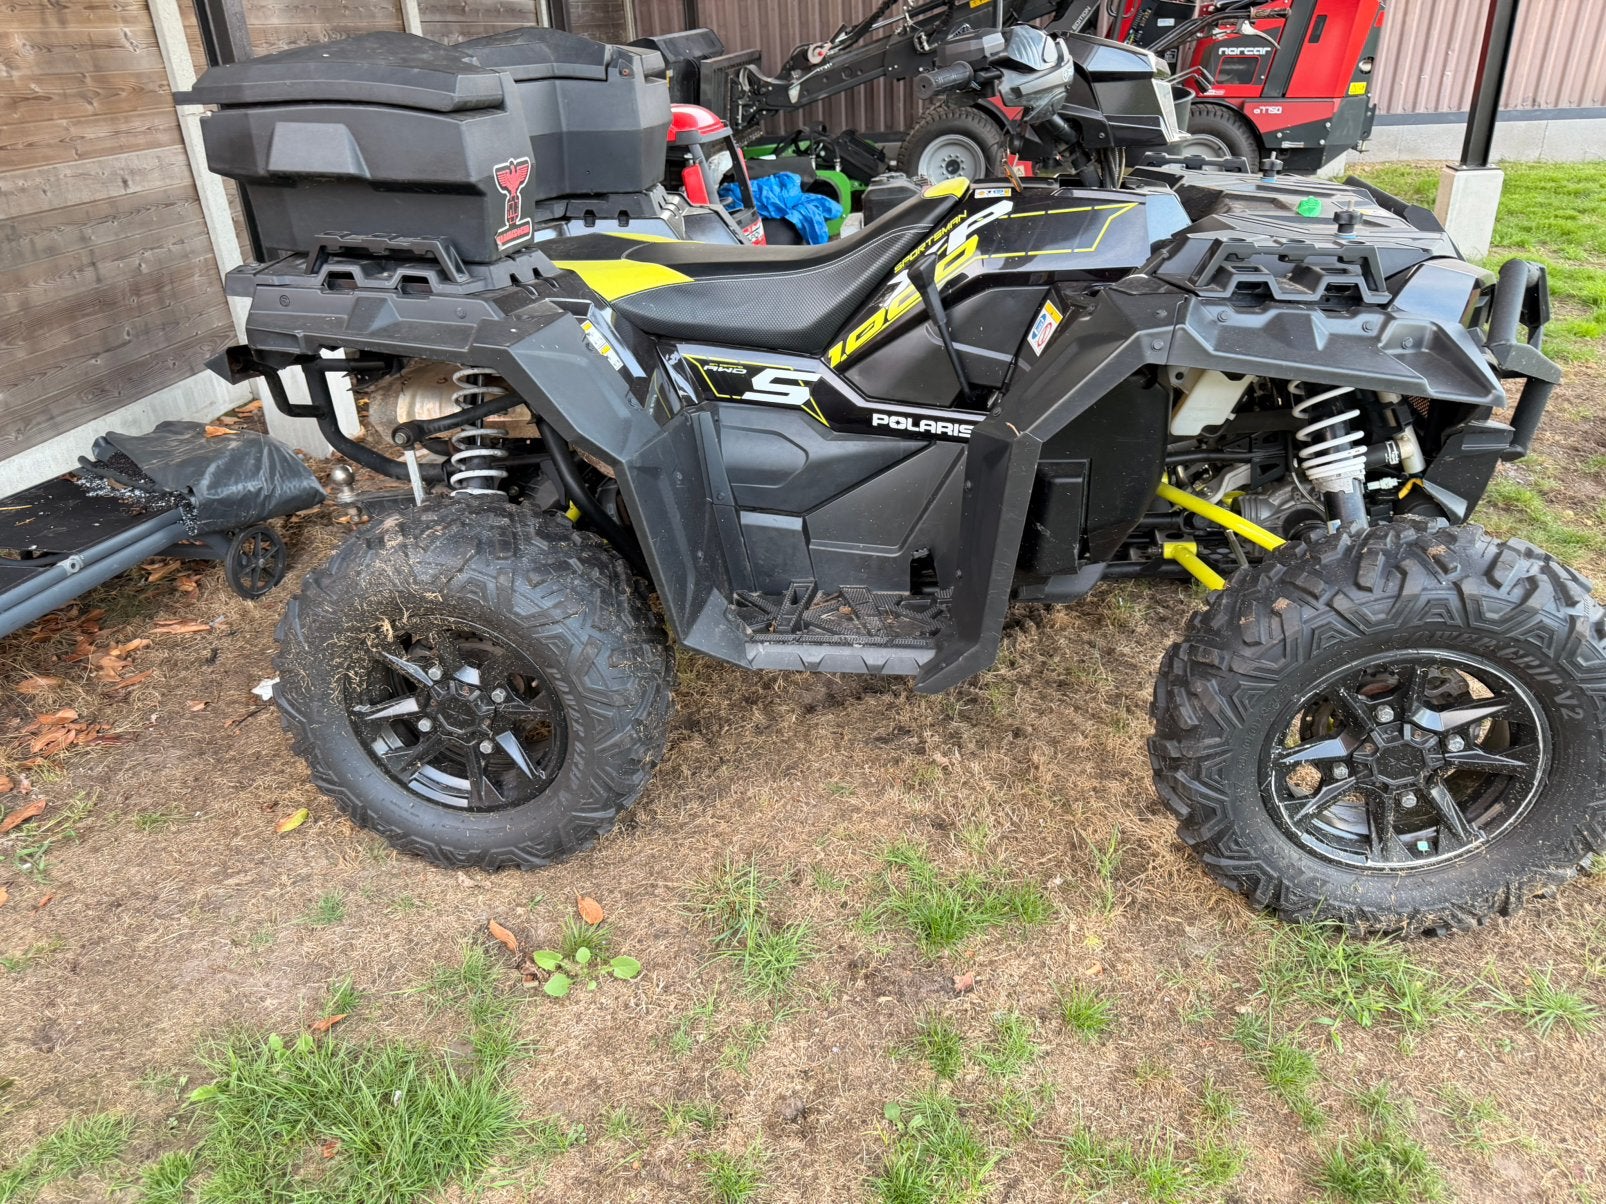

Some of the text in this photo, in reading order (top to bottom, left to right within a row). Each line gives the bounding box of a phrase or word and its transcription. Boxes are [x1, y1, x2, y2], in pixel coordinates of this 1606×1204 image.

[1218, 46, 1272, 56] norcar
[893, 209, 968, 274] SPORTSMAN
[703, 364, 748, 375] AWD
[741, 368, 823, 406] S
[872, 413, 975, 438] POLARIS
[1553, 689, 1585, 720] V2
